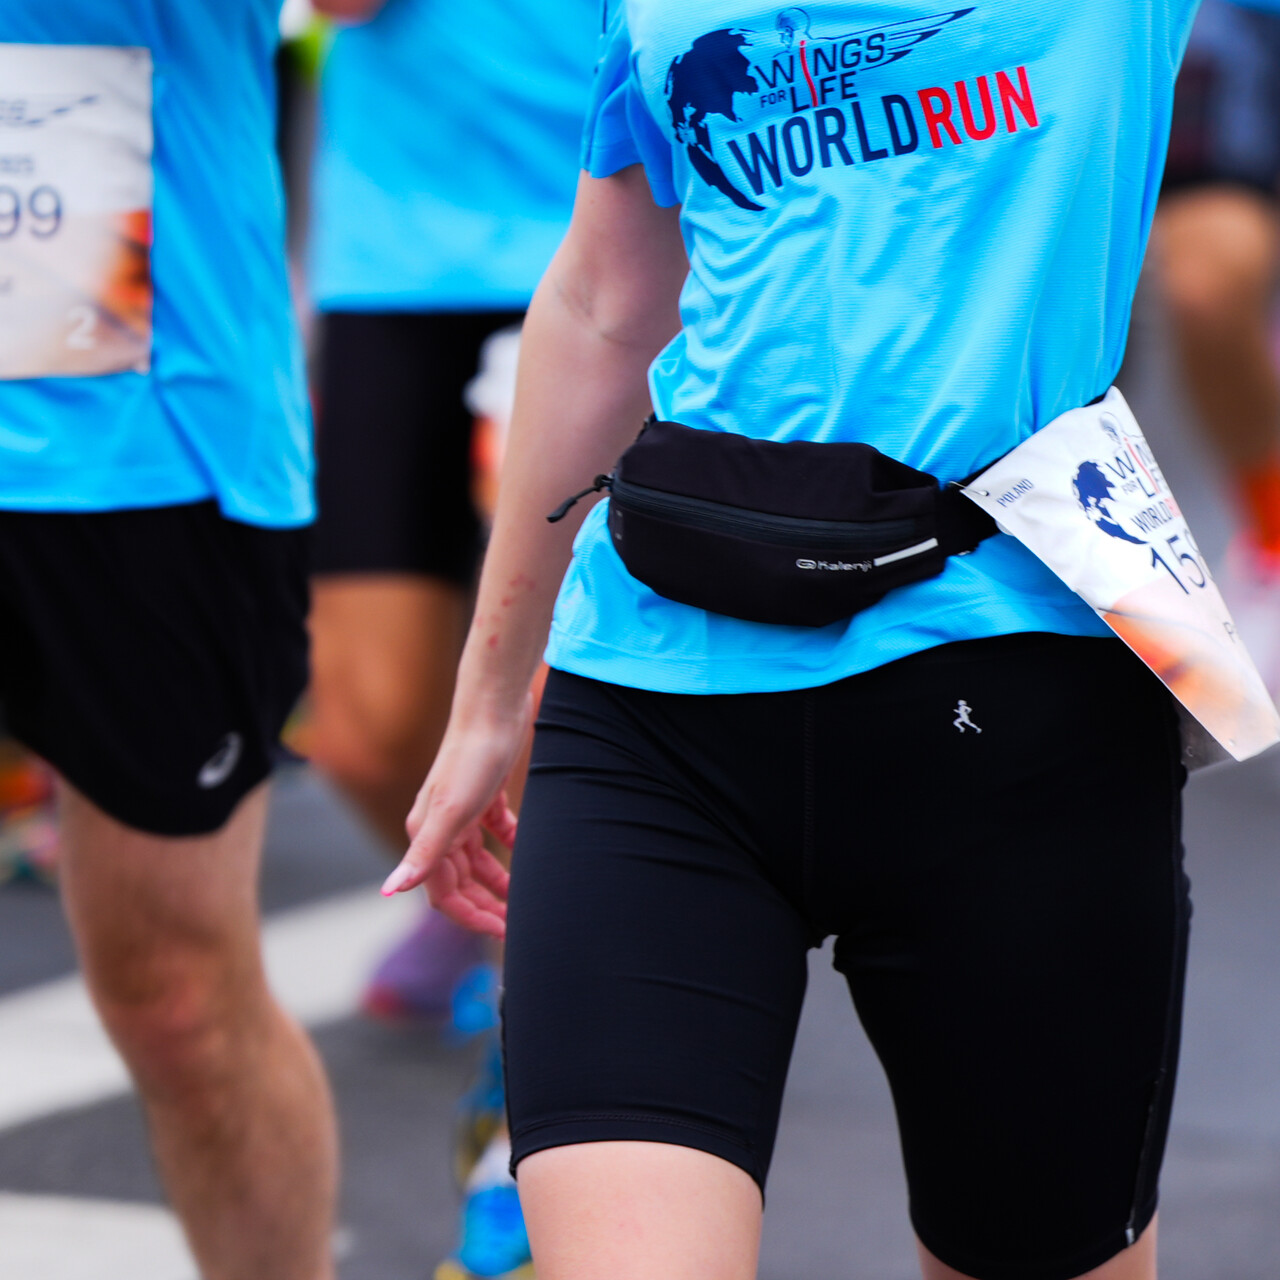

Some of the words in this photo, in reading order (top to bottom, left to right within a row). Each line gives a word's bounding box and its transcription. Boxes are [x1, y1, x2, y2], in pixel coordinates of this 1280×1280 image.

[754, 32, 887, 89] WINGS
[760, 89, 786, 109] FOR
[791, 70, 858, 113] LIFE
[67, 305, 100, 351] 2
[996, 478, 1035, 508] POLAND
[817, 559, 872, 572] Kalenji
